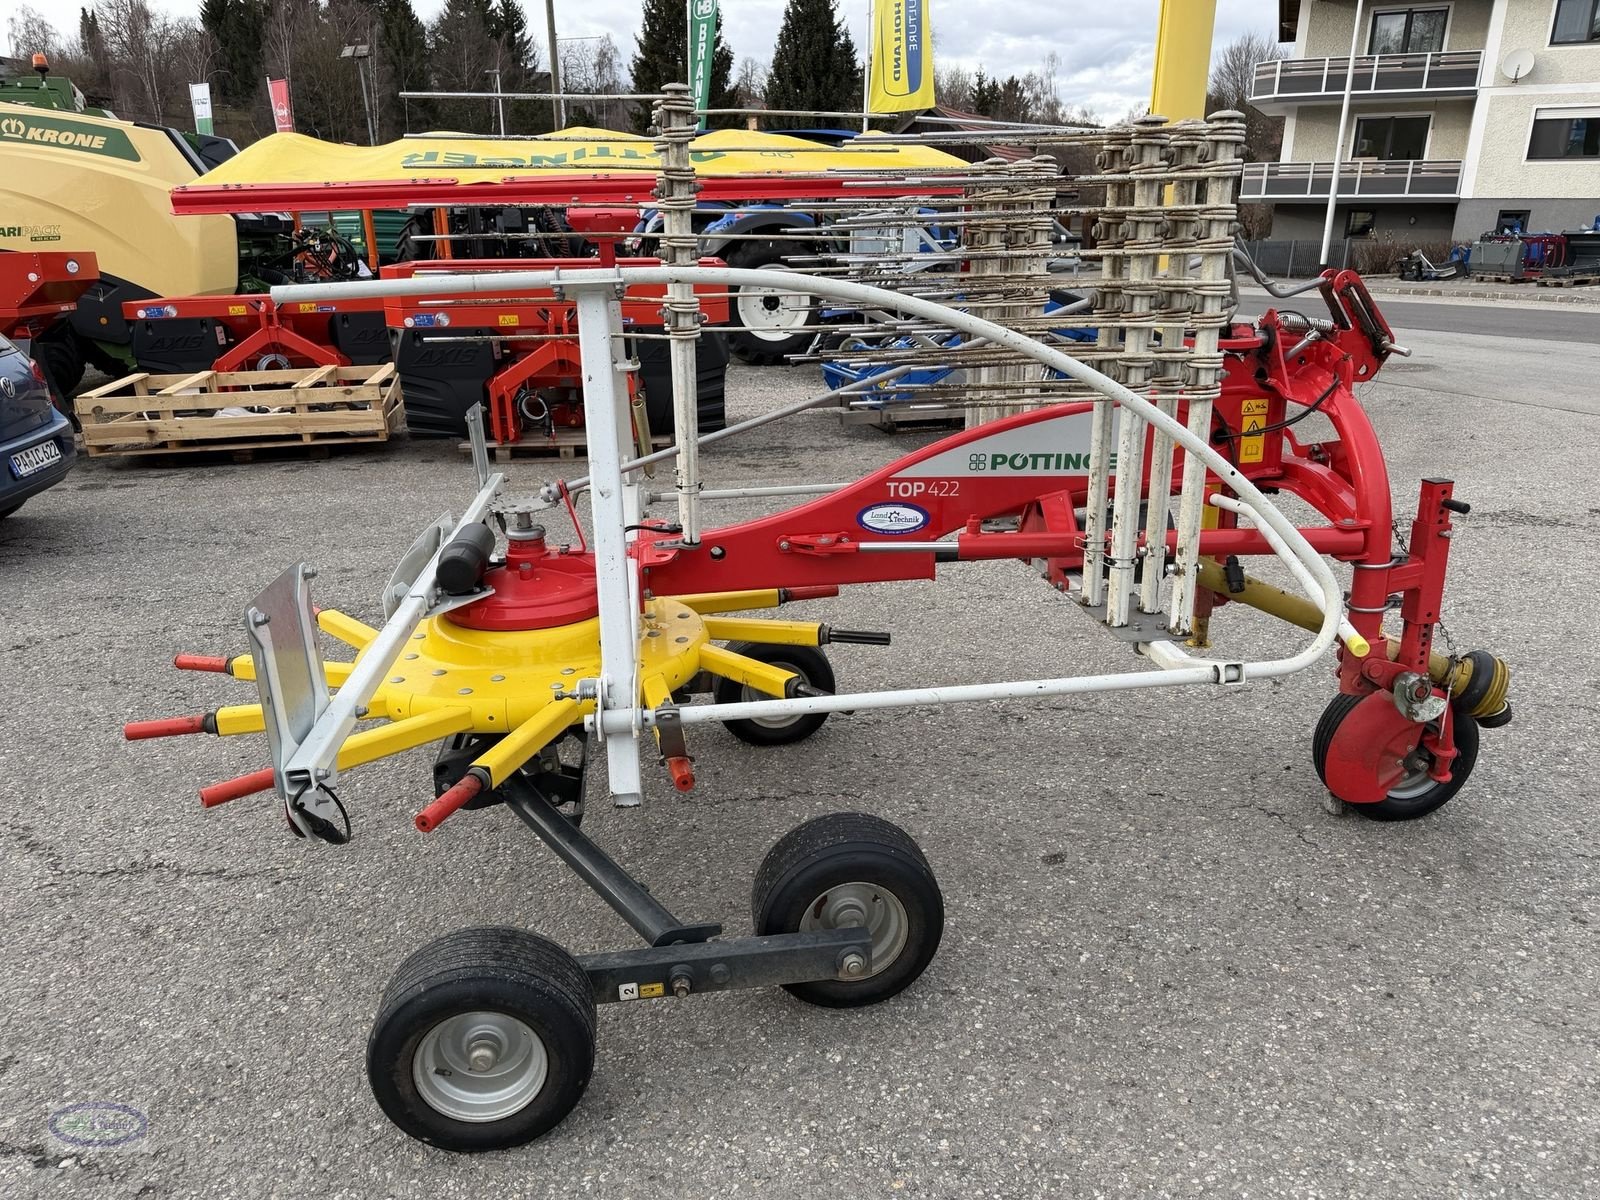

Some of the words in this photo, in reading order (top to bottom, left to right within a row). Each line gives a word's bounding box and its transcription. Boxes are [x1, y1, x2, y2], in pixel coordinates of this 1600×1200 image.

[695, 23, 707, 131] BRANT
[25, 127, 107, 149] KRONE
[149, 335, 205, 350] AXIS
[413, 347, 480, 365] AXIS
[13, 454, 31, 473] PA
[42, 442, 60, 461] 622
[990, 452, 1118, 471] PÖTTINE
[886, 482, 926, 498] TOP
[927, 481, 960, 497] 422
[870, 511, 889, 519] Land
[893, 515, 920, 523] Technik
